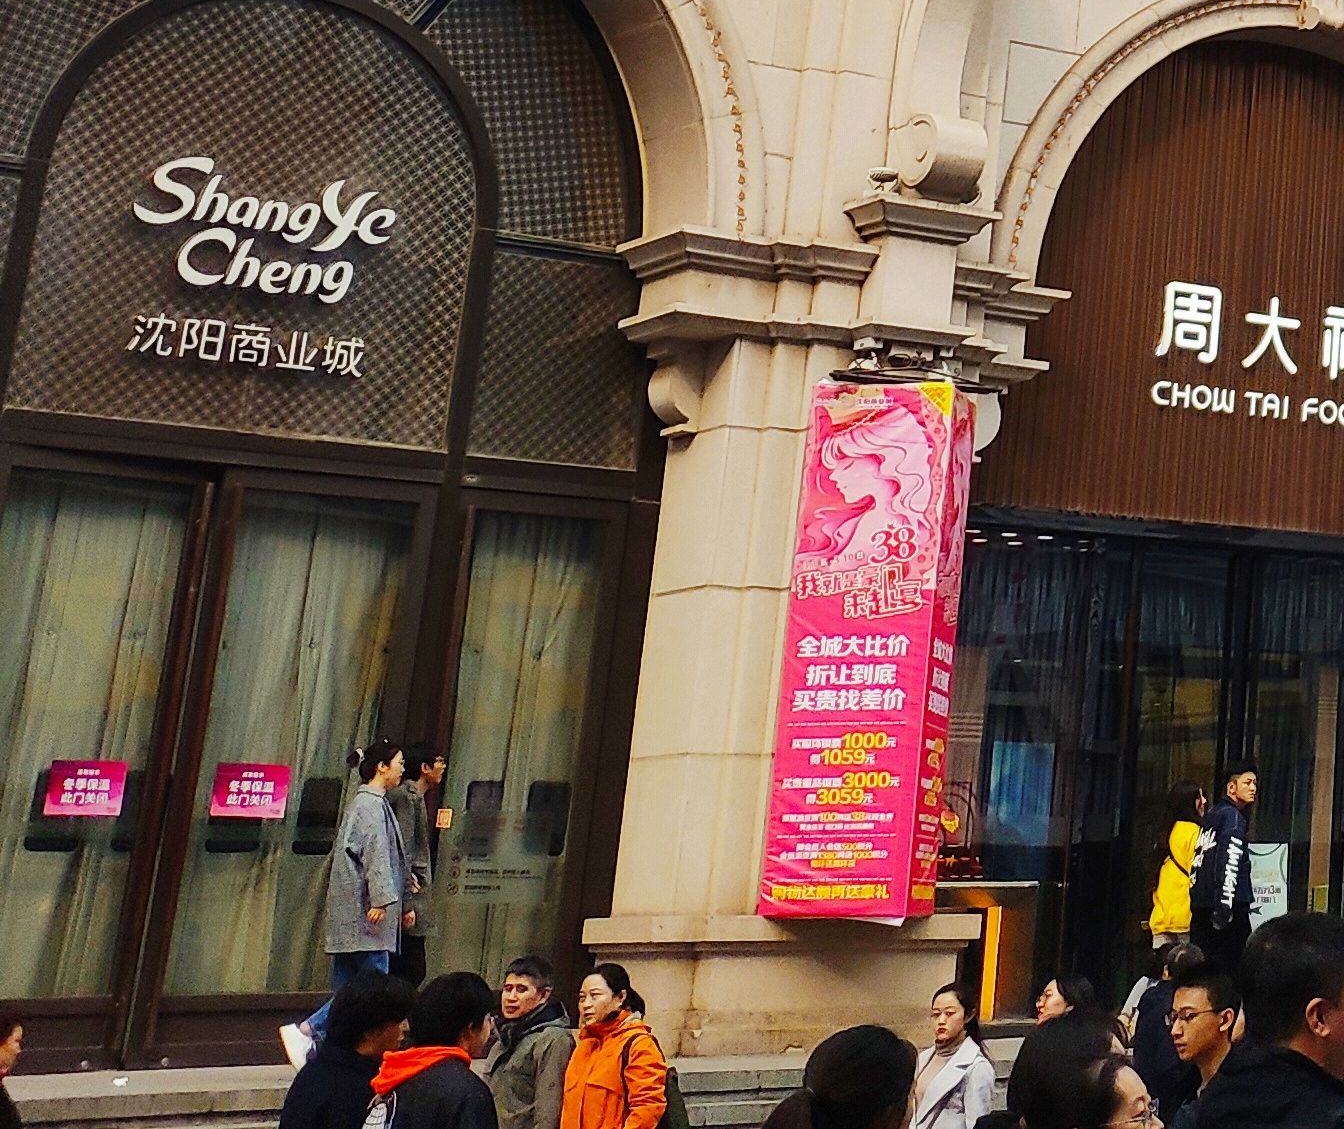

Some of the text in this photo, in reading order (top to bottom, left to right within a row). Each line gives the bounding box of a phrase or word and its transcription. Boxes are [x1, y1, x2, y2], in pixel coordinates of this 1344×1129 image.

[133, 156, 397, 252] ShangYe
[176, 228, 355, 304] Cheng
[126, 313, 365, 378] 沈阳商业城
[1150, 380, 1236, 414] CHOW
[1243, 391, 1290, 420] TAI
[869, 524, 917, 564] 38
[796, 634, 911, 658] 全城大比价
[805, 663, 897, 687] 折让到底
[791, 688, 907, 712] 买贵找差价
[60, 791, 109, 804] 此门关闭
[226, 793, 273, 806] 此门关闭
